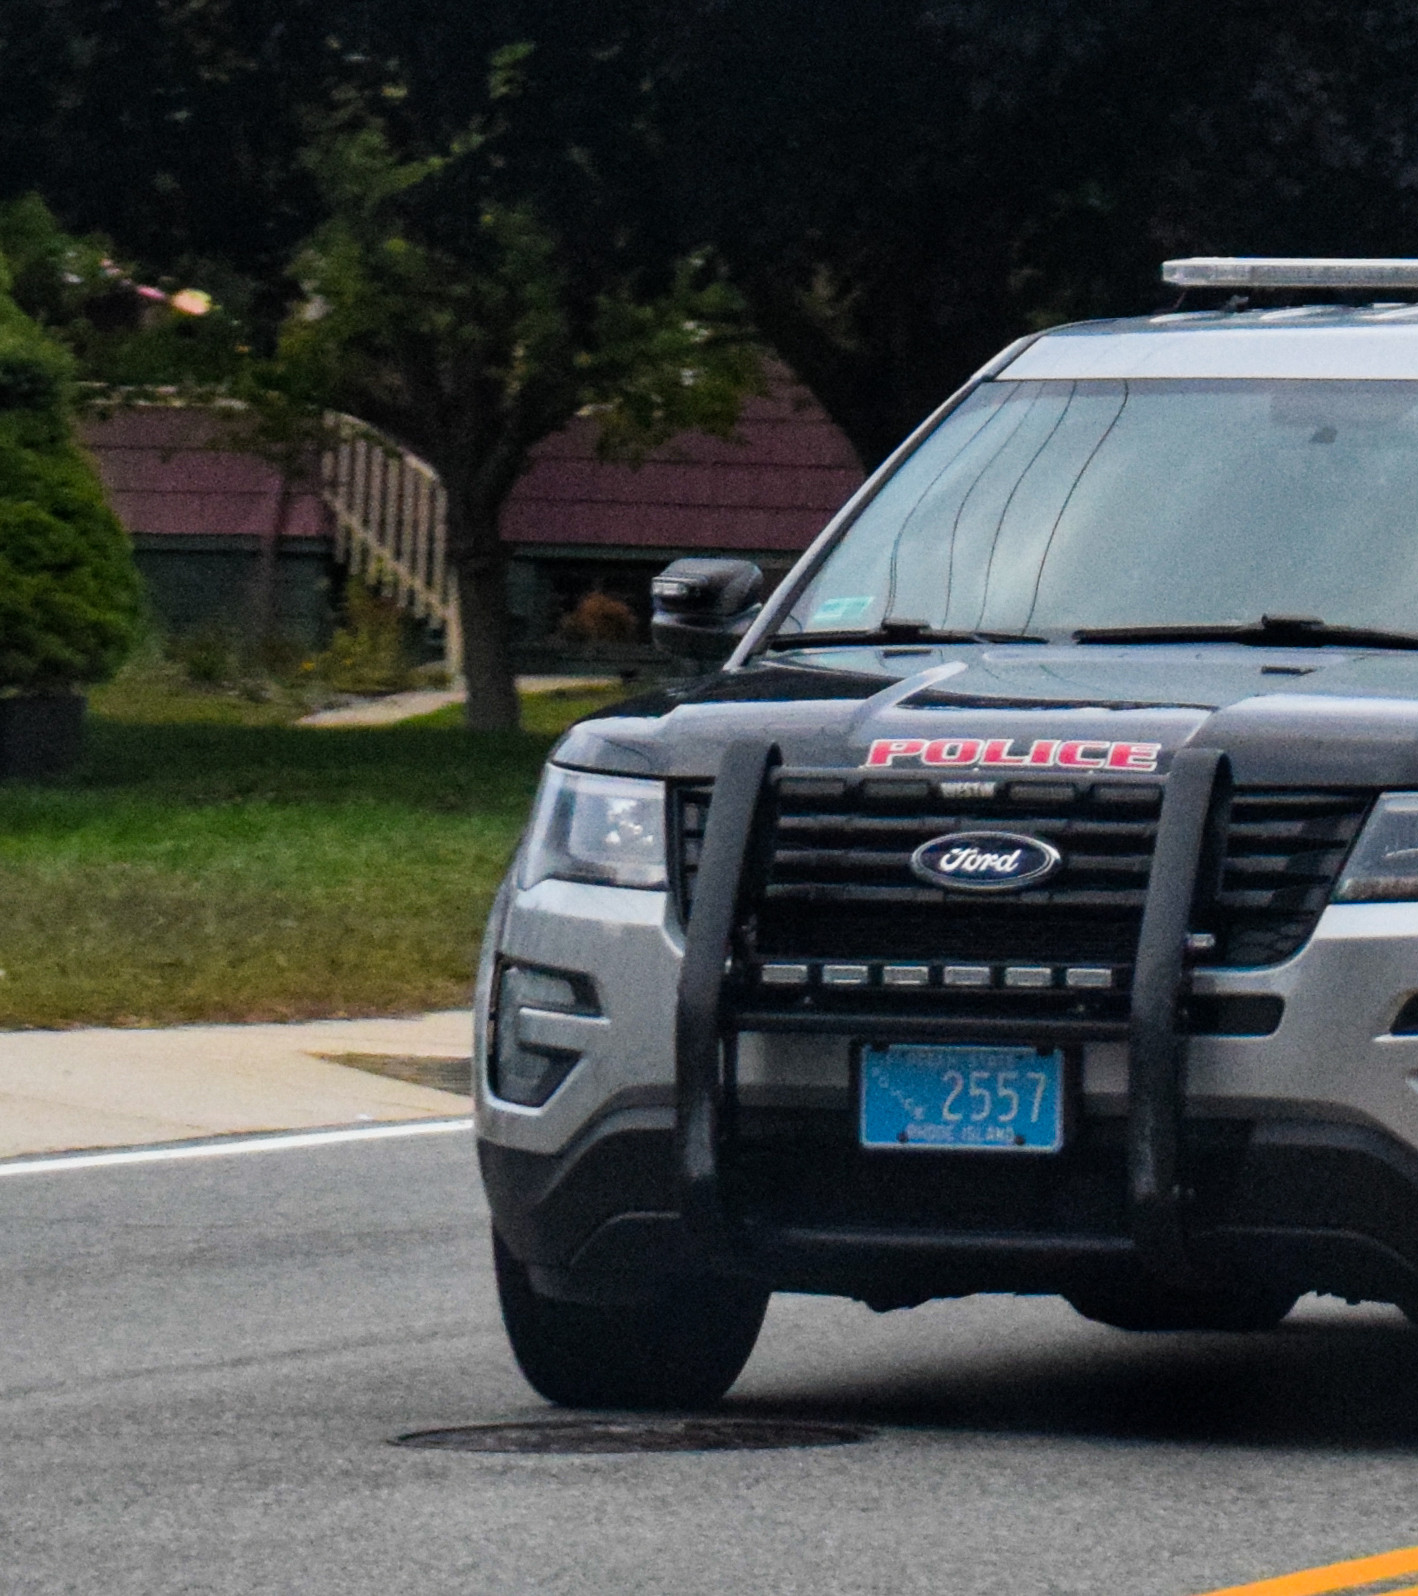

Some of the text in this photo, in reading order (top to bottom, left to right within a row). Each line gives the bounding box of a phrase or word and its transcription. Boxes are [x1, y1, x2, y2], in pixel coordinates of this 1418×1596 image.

[862, 738, 1162, 772] POLICE
[940, 847, 1021, 872] Ford
[942, 1068, 1047, 1123] 2557
[960, 1125, 1016, 1143] ISLAND
